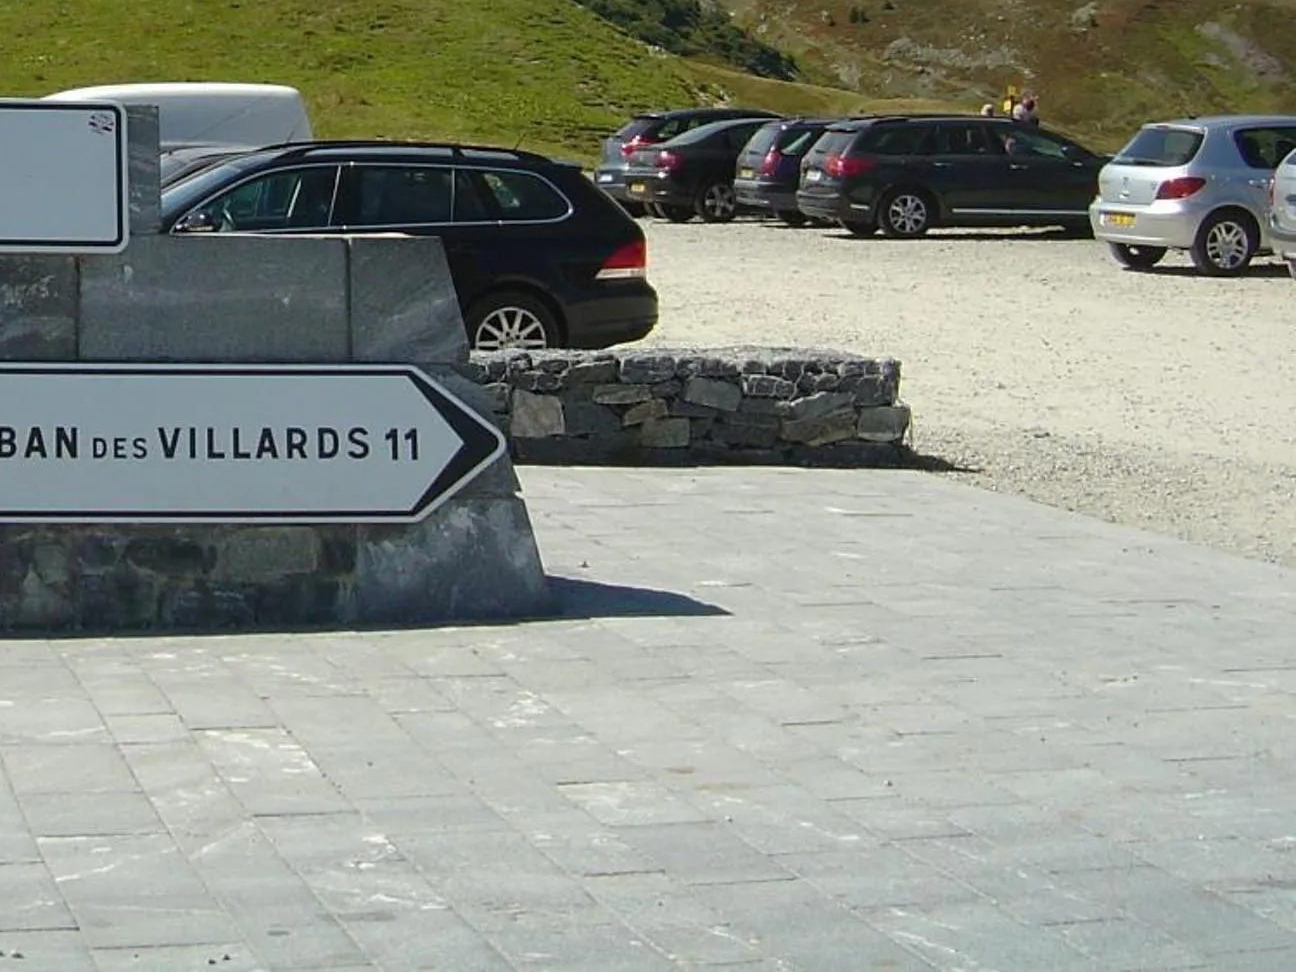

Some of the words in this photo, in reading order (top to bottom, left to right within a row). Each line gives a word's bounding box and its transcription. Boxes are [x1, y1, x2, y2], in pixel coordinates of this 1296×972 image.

[92, 437, 149, 460] DES
[157, 426, 371, 461] VILLARDS
[384, 427, 420, 461] 11
